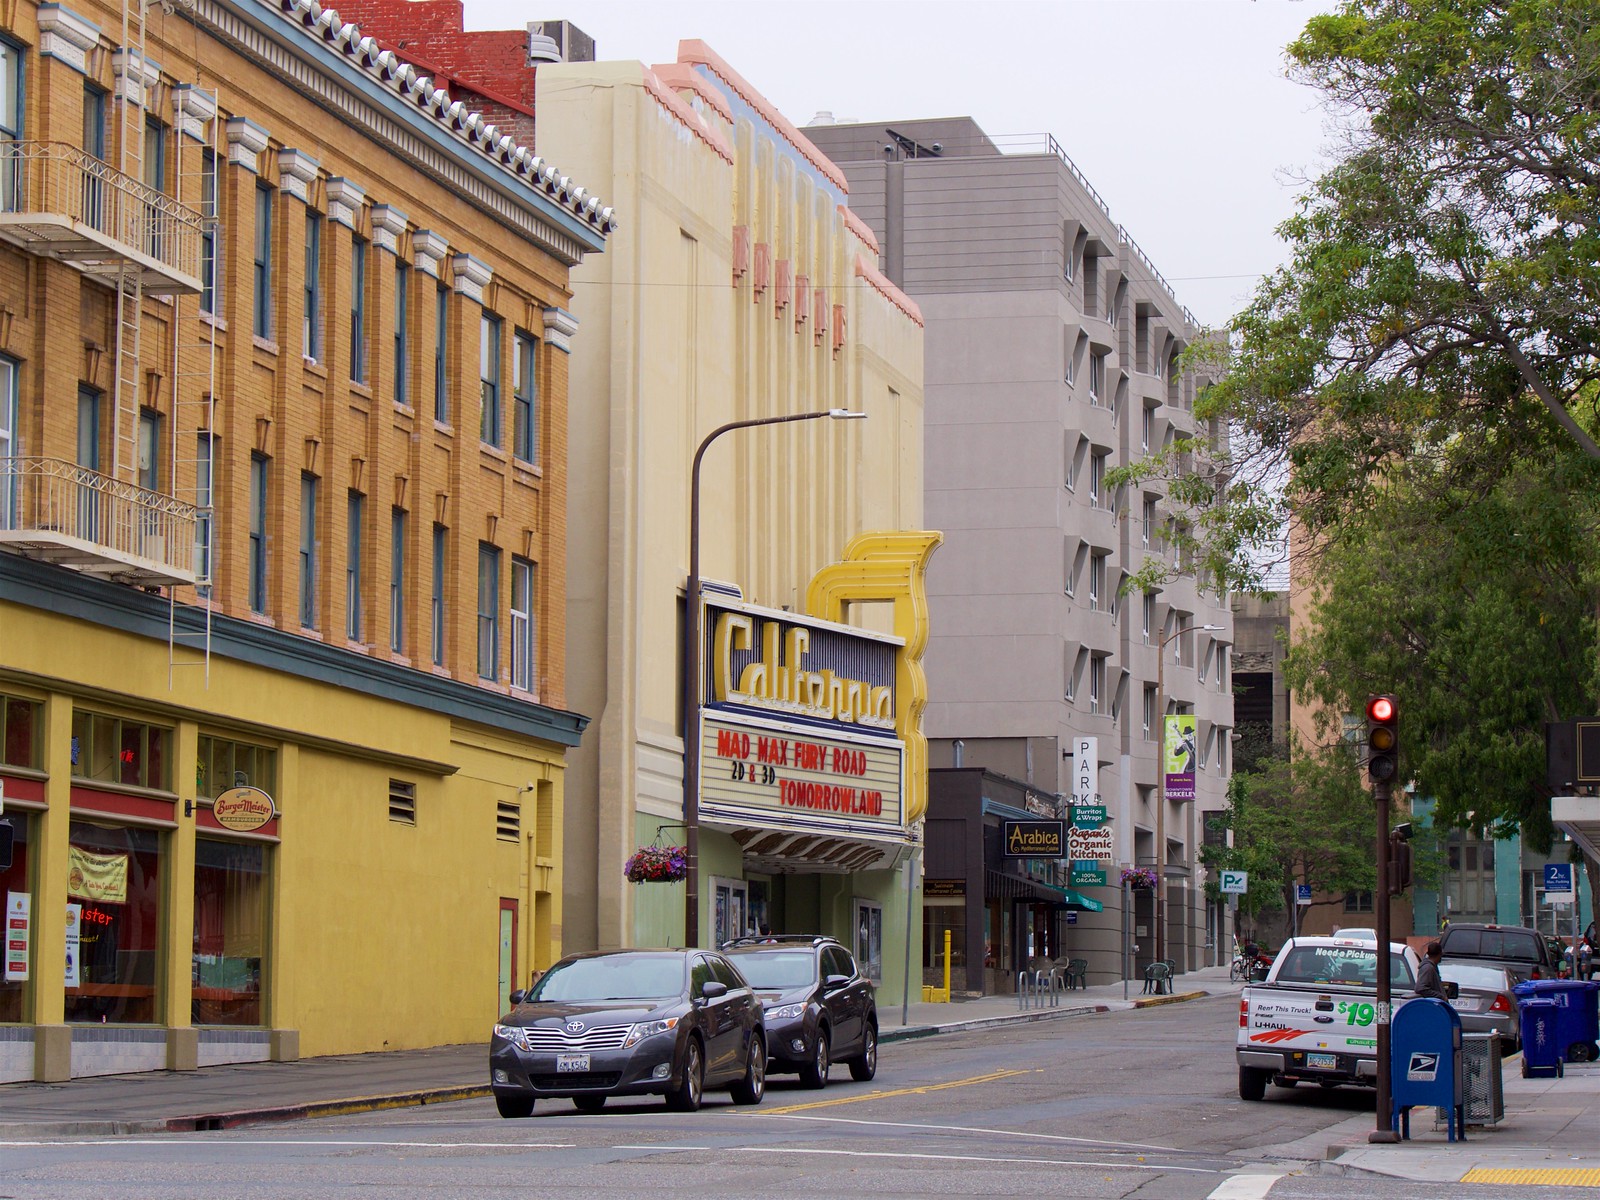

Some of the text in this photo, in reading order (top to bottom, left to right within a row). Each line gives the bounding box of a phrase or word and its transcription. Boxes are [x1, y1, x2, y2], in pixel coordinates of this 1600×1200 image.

[714, 612, 897, 730] California
[717, 730, 867, 776] MAD MAX FURY ROAD
[731, 761, 776, 785] 2D & 3D
[1080, 742, 1091, 805] PARK
[778, 779, 882, 816] TOMORROWLAND
[1009, 824, 1059, 853] Arabica
[1069, 827, 1110, 840] Razan's
[1070, 839, 1111, 850] Organic
[1070, 849, 1111, 859] Kitchen
[1550, 867, 1558, 879] 2
[80, 908, 113, 925] ister
[1315, 948, 1339, 957] Need
[1290, 1006, 1312, 1014] Truck!
[1254, 1021, 1288, 1030] U-HAUL
